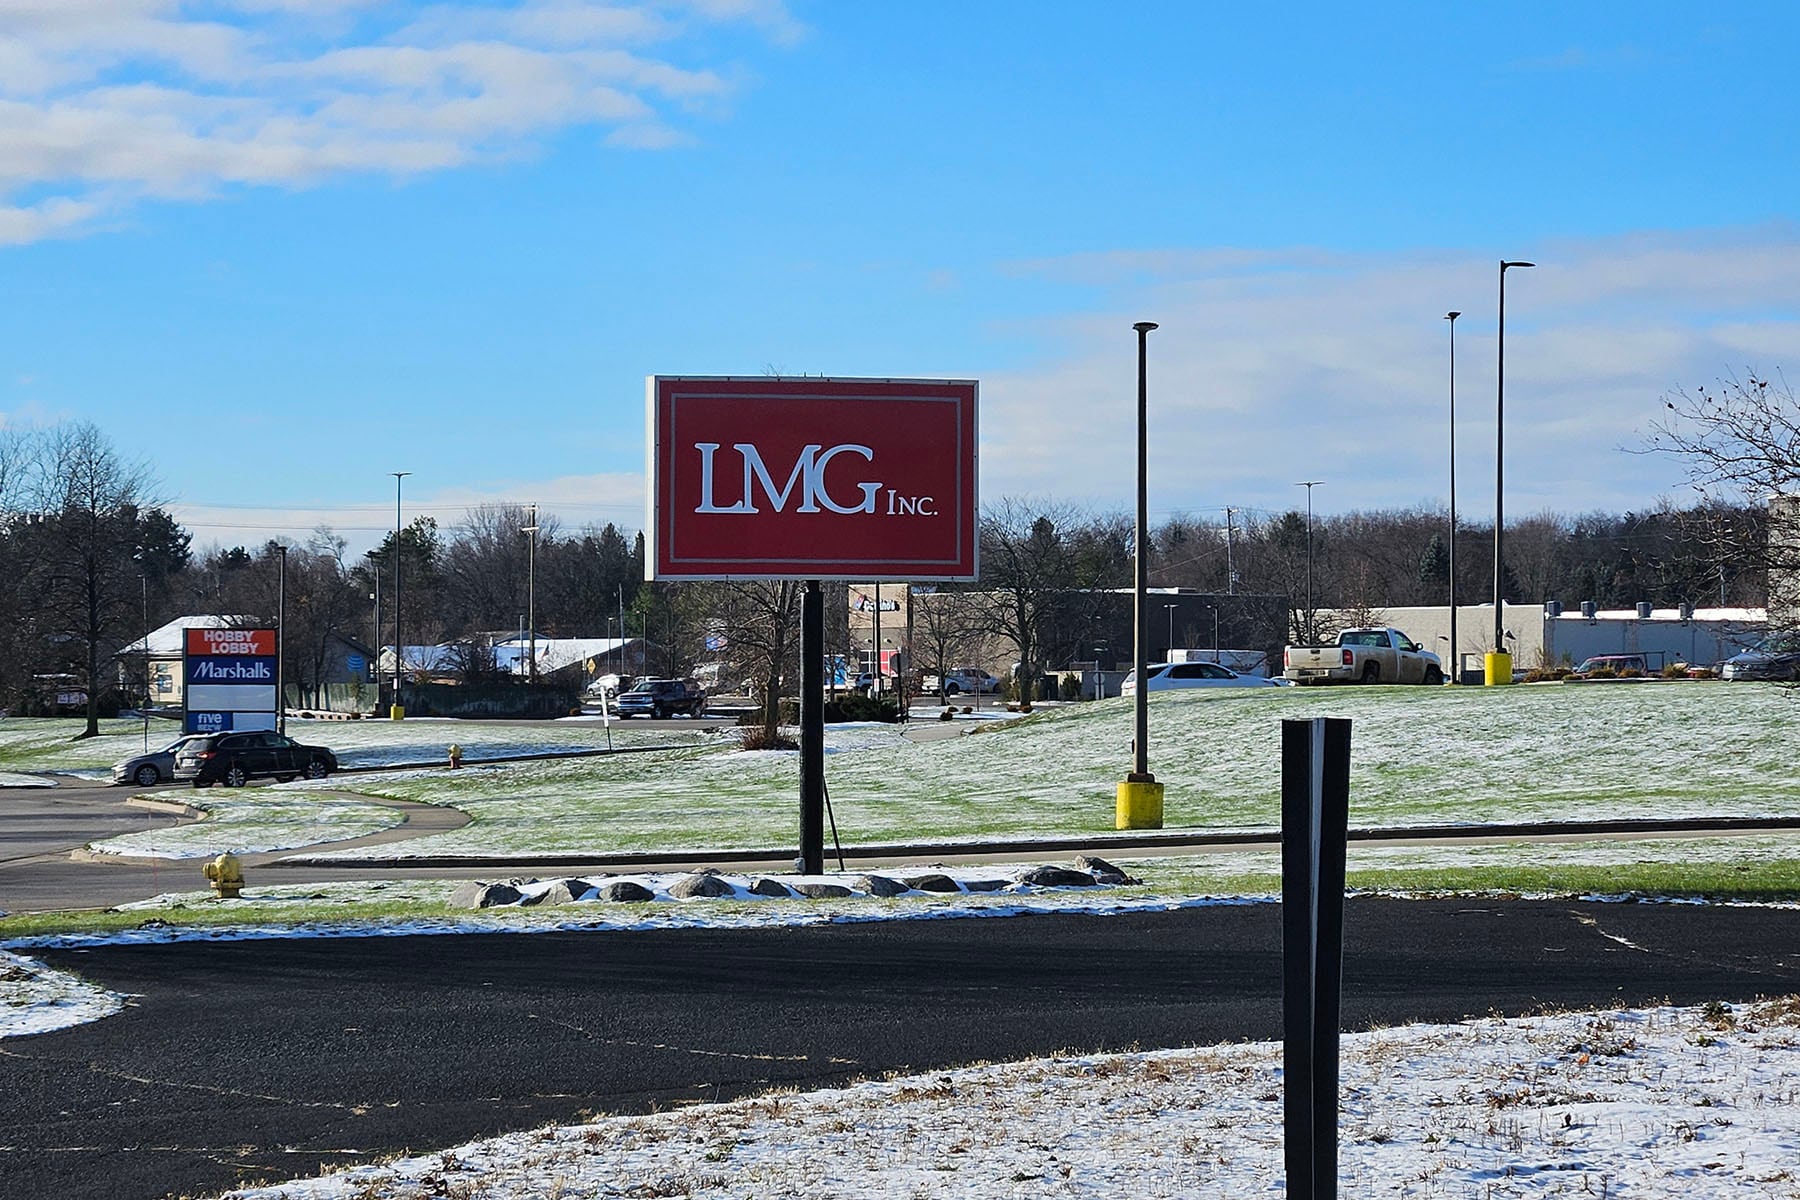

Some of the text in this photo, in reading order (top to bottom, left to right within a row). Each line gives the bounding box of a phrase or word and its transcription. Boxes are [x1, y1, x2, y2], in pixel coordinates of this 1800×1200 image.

[694, 442, 883, 515] LMG
[204, 630, 255, 642] HOBBY
[211, 642, 259, 654] LOBBY
[193, 661, 271, 678] Marshalls
[198, 713, 223, 724] five
